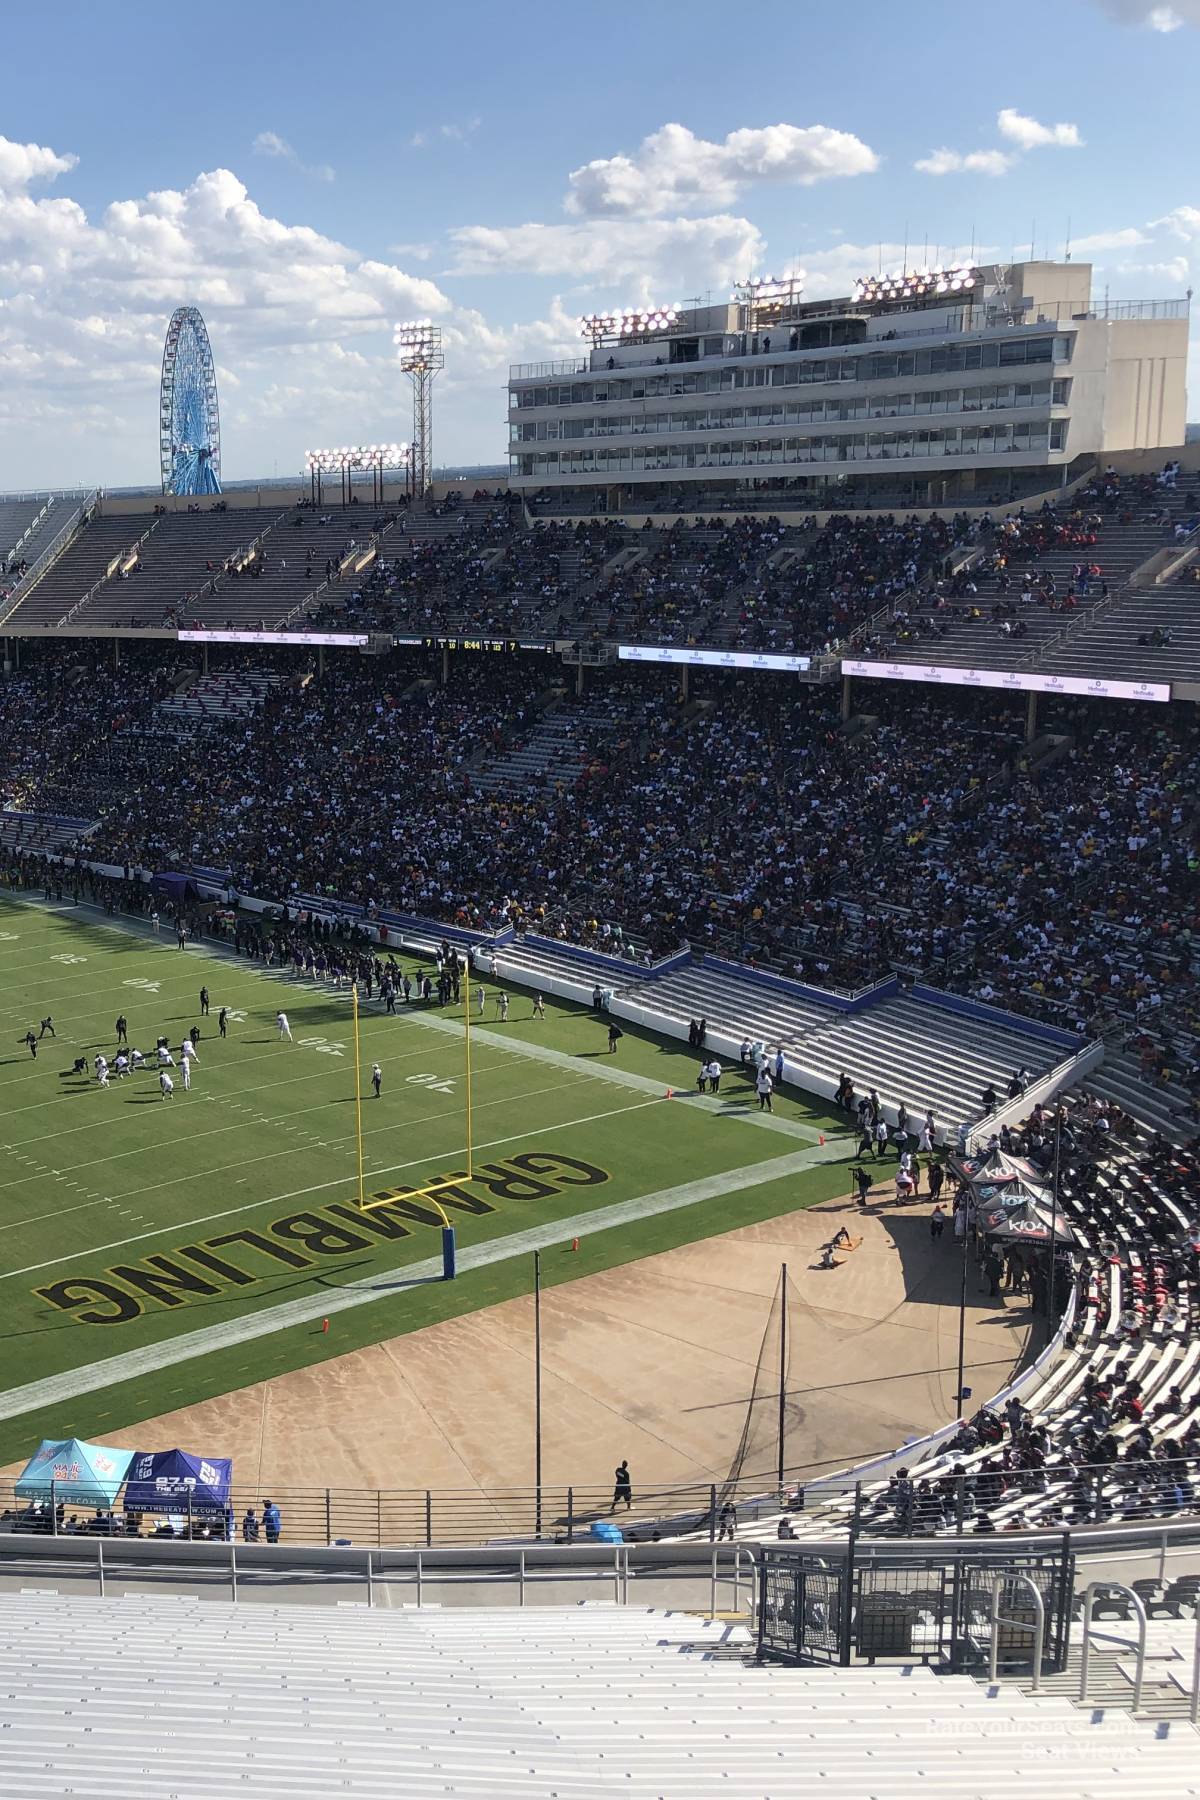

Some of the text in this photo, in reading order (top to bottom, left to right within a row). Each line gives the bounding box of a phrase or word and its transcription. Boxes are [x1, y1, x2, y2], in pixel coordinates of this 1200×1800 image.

[464, 640, 480, 650] 8:44
[50, 953, 88, 965] 50
[122, 978, 162, 989] 40
[297, 1036, 343, 1054] 20
[405, 1073, 457, 1090] 10
[32, 1152, 612, 1326] GRAMBLING
[52, 1461, 83, 1473] MAJIC
[155, 1476, 197, 1487] 97.9
[128, 1505, 217, 1515] WWW.THEBEATDW.COM
